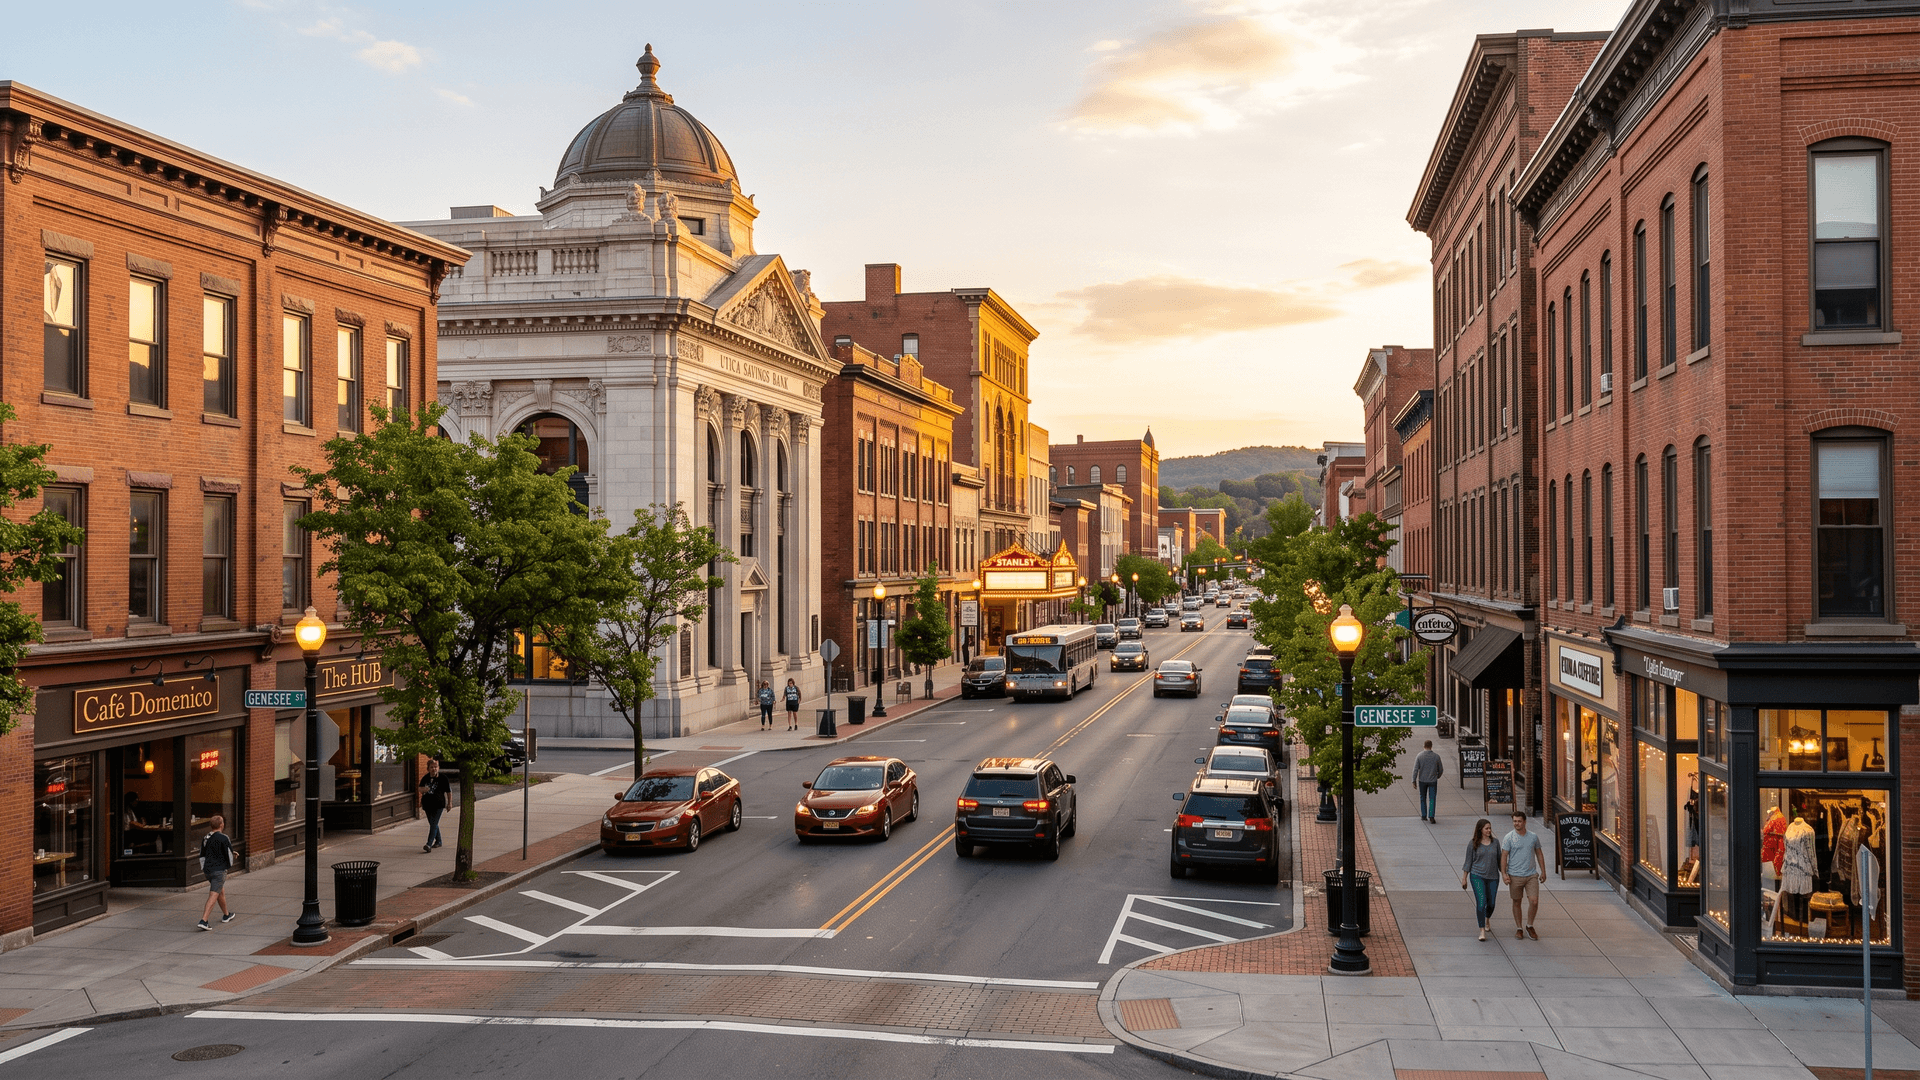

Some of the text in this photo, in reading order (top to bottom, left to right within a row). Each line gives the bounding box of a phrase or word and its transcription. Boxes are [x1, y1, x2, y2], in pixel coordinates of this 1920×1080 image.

[720, 355, 789, 390] UTICA SAVINGS BANK
[322, 662, 382, 690] The HUB
[83, 686, 212, 723] Café Domenico
[248, 693, 304, 706] GENESEE ST
[1360, 709, 1431, 724] GENESEE ST
